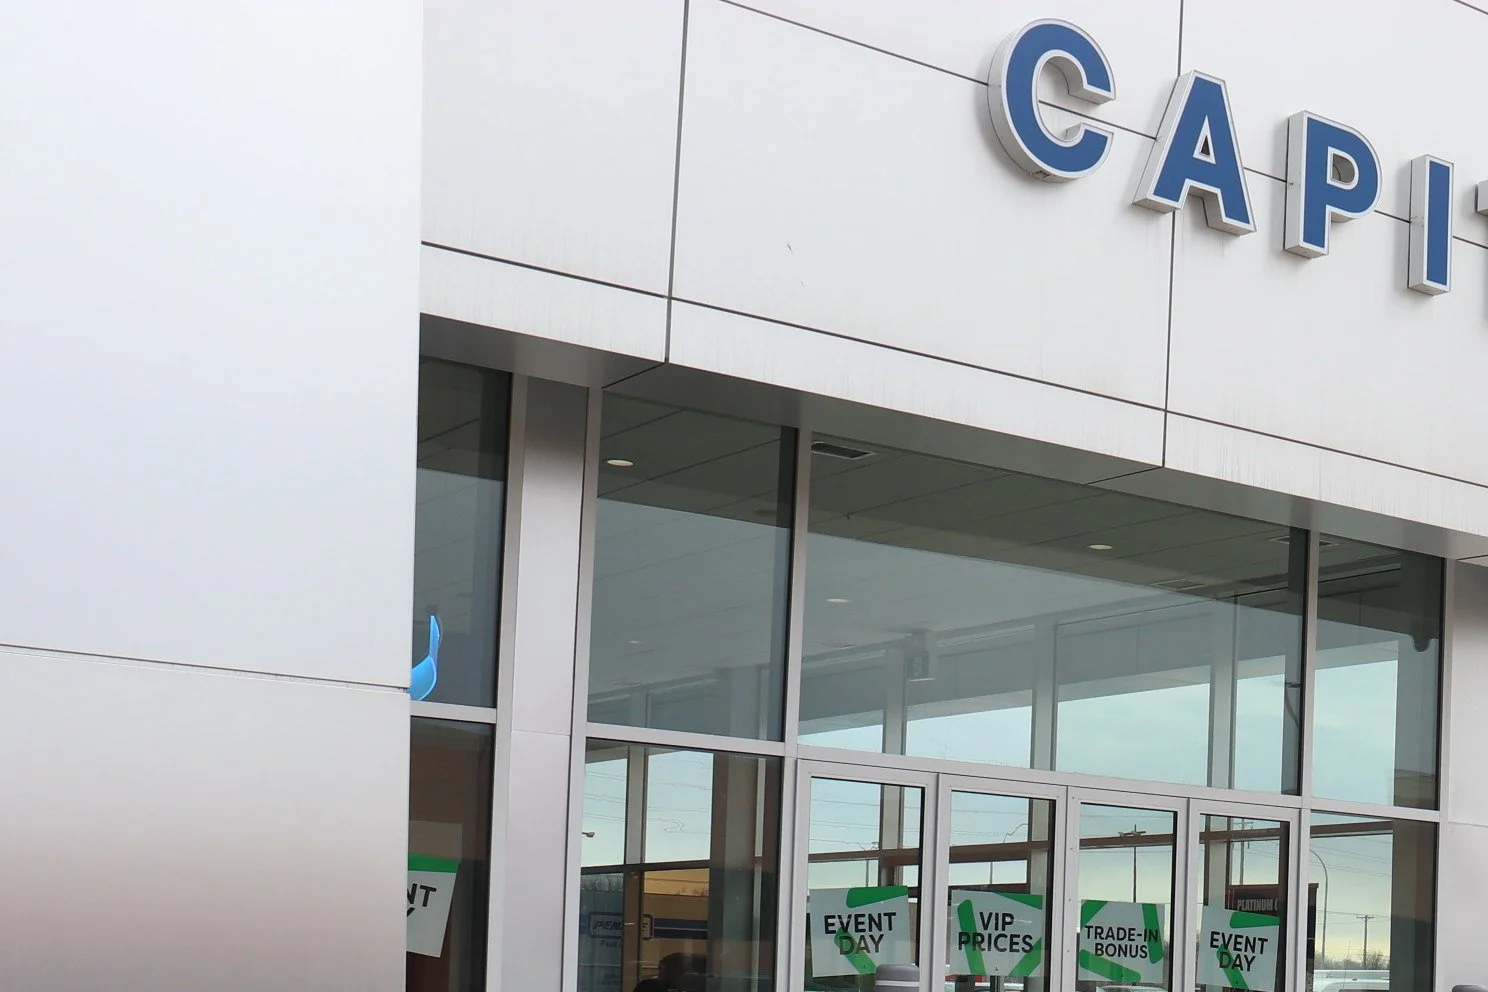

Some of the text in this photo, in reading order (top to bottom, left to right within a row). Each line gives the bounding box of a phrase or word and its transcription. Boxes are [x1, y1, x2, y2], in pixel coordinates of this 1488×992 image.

[1236, 899, 1274, 912] PLATINUM
[824, 911, 897, 935] EVENT
[979, 911, 1015, 932] VIP
[838, 933, 885, 956] DAY
[958, 931, 1034, 954] PRICES
[1084, 925, 1159, 943] TRADE-IN
[1209, 931, 1269, 955] EVENT
[1094, 942, 1148, 959] BONUS
[1219, 951, 1257, 972] DAY
